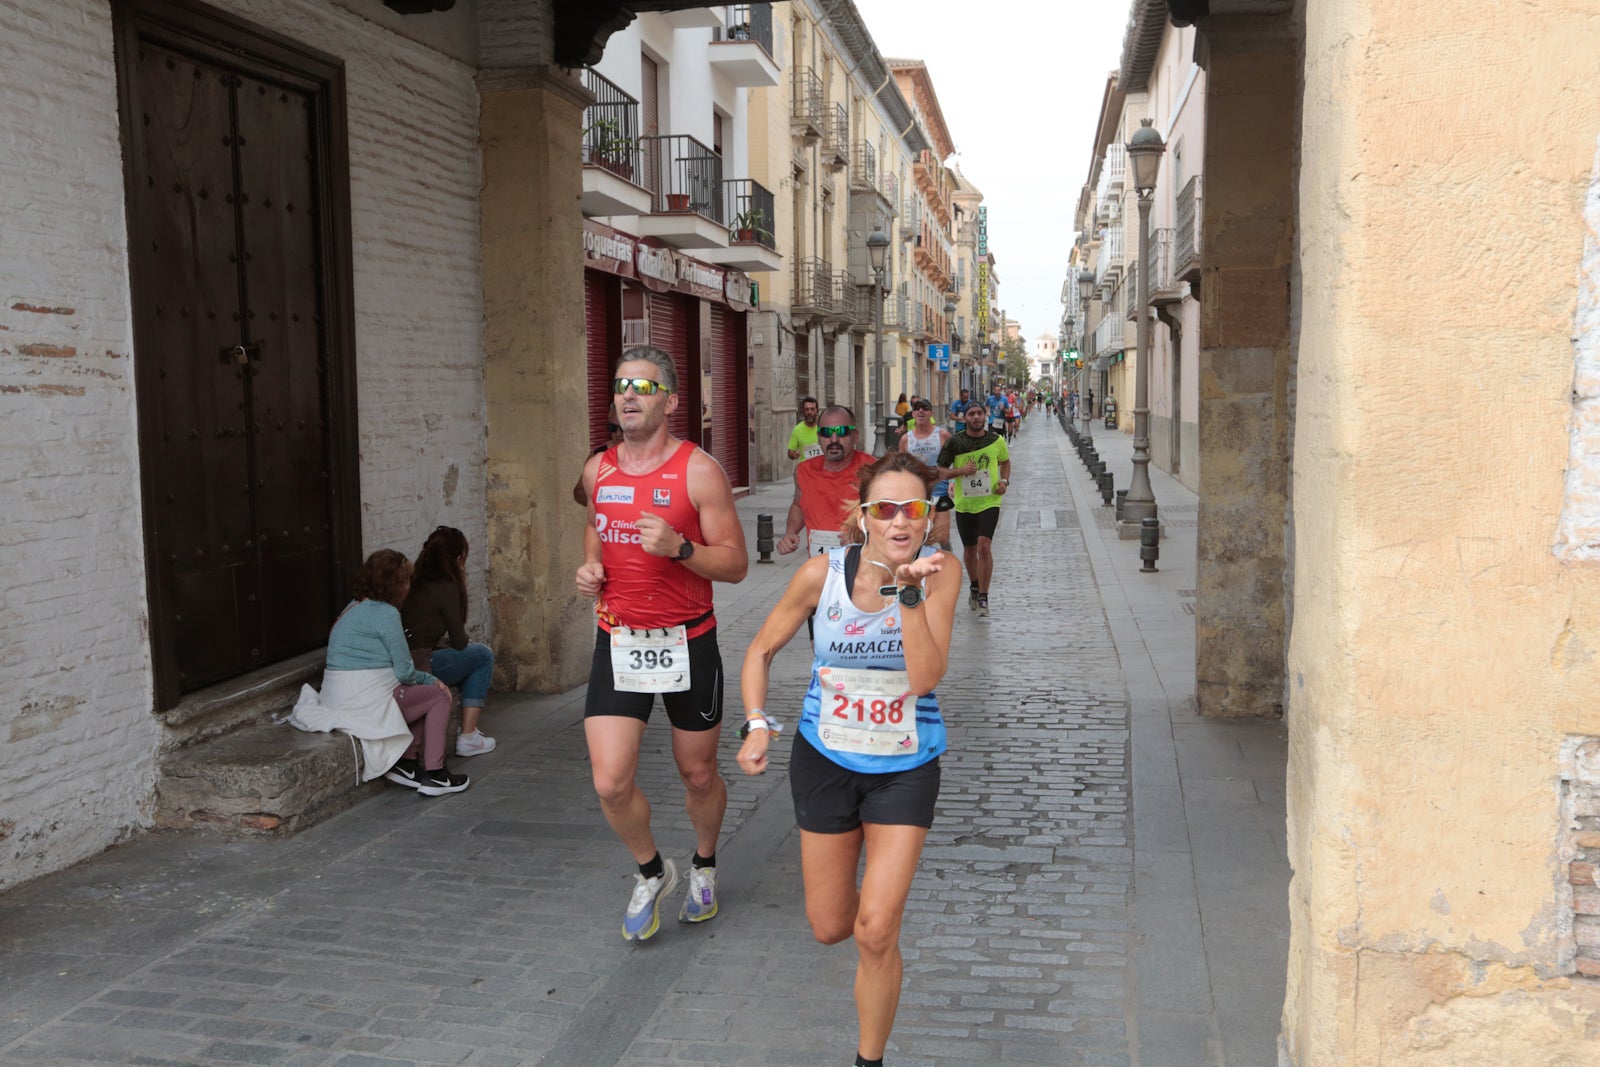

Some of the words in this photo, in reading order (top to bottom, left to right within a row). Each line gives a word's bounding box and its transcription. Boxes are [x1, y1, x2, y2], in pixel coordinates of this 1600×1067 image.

[979, 207, 987, 255] TEJIDOS
[583, 231, 632, 262] roguerías
[979, 262, 988, 344] CONFECCION
[970, 479, 982, 488] 64
[629, 649, 673, 670] 396
[829, 640, 905, 654] MARACEN
[832, 694, 904, 724] 2188
